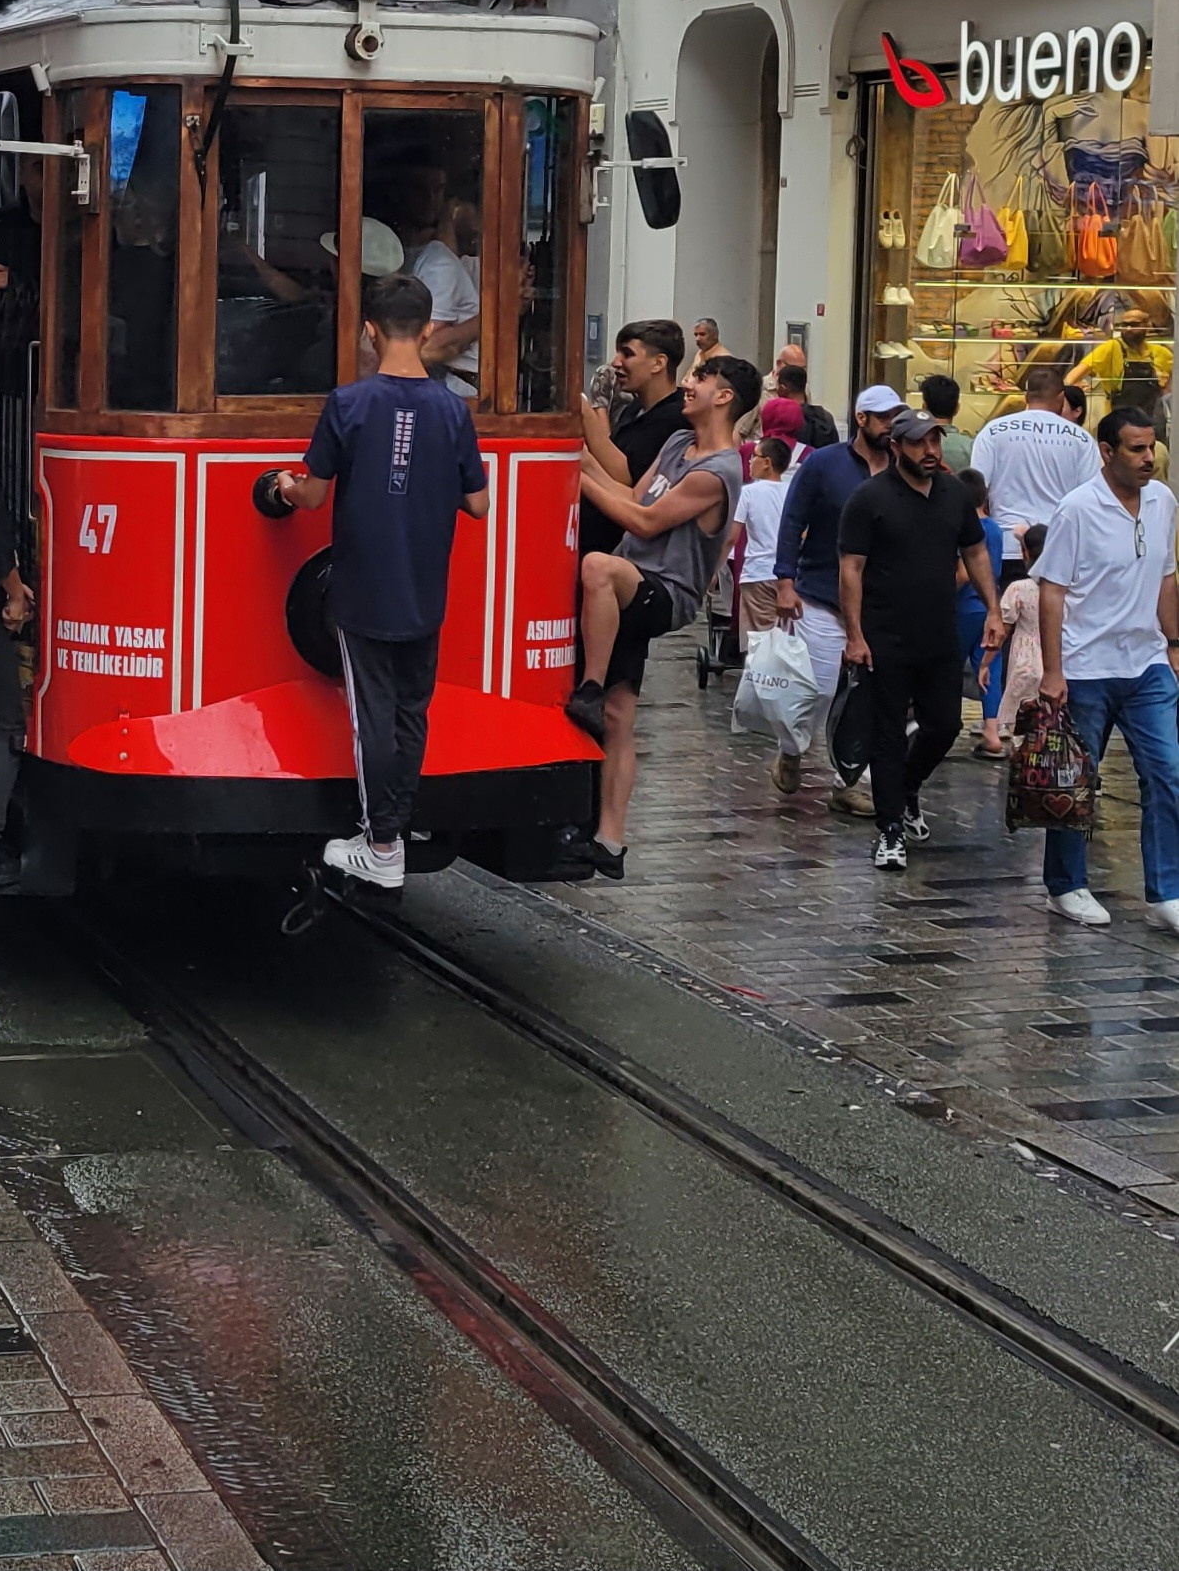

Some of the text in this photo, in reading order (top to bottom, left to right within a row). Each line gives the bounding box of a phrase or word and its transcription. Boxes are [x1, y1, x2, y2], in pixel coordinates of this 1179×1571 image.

[959, 20, 1142, 106] bueno
[393, 410, 414, 466] PUMA
[989, 419, 1089, 443] ESSENTIALS
[79, 504, 118, 554] 47
[56, 619, 166, 649] ASILMAK YASAK
[526, 618, 570, 641] ASILMAK
[56, 647, 164, 679] VE TEHLİKELİDİR
[526, 648, 542, 670] VE
